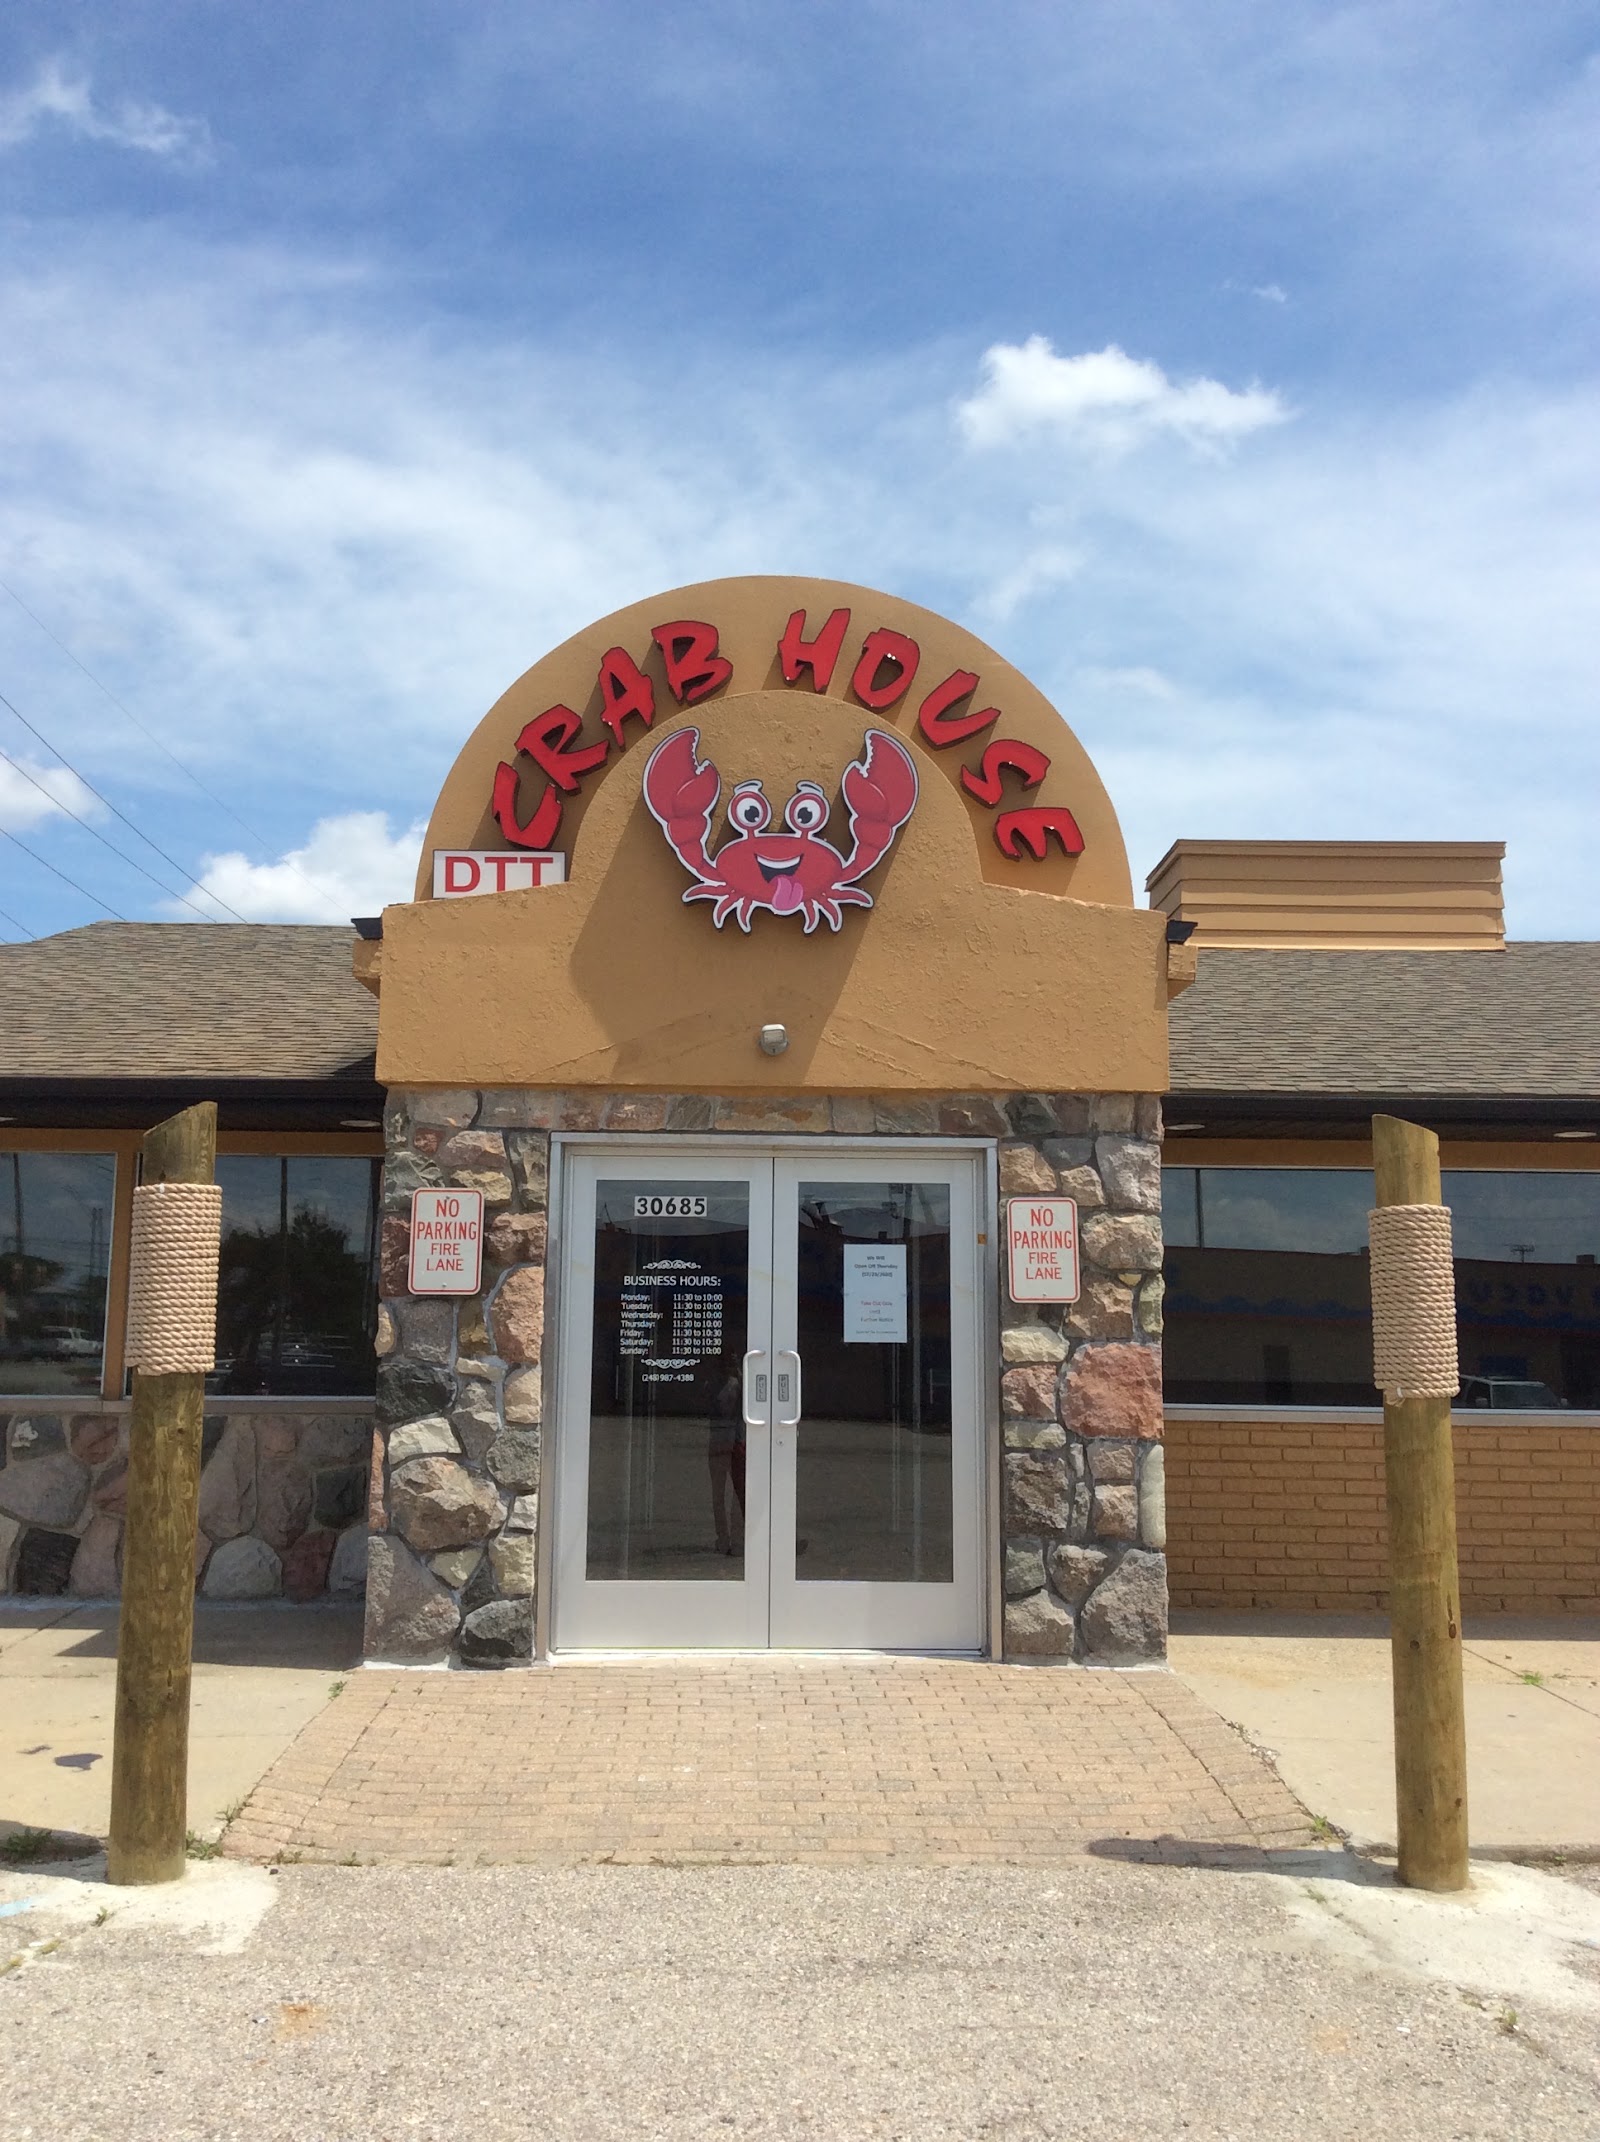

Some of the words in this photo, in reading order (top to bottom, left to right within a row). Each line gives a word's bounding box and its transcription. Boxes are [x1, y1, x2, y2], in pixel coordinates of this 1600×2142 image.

[493, 620, 733, 850] CRAB
[778, 608, 1085, 860] HOUSE
[445, 856, 553, 892] DTT
[436, 1199, 460, 1218] NO
[637, 1197, 706, 1215] 30685
[1030, 1208, 1054, 1227] NO
[417, 1221, 477, 1240] PARKING
[1014, 1230, 1072, 1249] PARKING
[431, 1243, 461, 1255] FIRE
[1028, 1252, 1058, 1264] FIRE
[426, 1258, 464, 1271] LANE
[1025, 1267, 1062, 1280] LANE
[623, 1275, 677, 1286] BUSINESS
[680, 1276, 722, 1287] HOURS:
[621, 1294, 650, 1302] Monday:
[621, 1302, 653, 1310] Tuesday:
[621, 1311, 664, 1320] Wednesday:
[673, 1311, 693, 1319] 11:30
[694, 1311, 702, 1319] to
[621, 1320, 656, 1328] Thursday:
[620, 1329, 645, 1338] Friday:
[672, 1329, 692, 1337] 11:30
[693, 1329, 701, 1337] to
[620, 1338, 654, 1347] Saturday:
[672, 1338, 692, 1346] 11:30
[693, 1338, 701, 1346] to
[620, 1347, 649, 1356] Sunday:
[672, 1347, 692, 1355] 11:30
[693, 1347, 701, 1355] to
